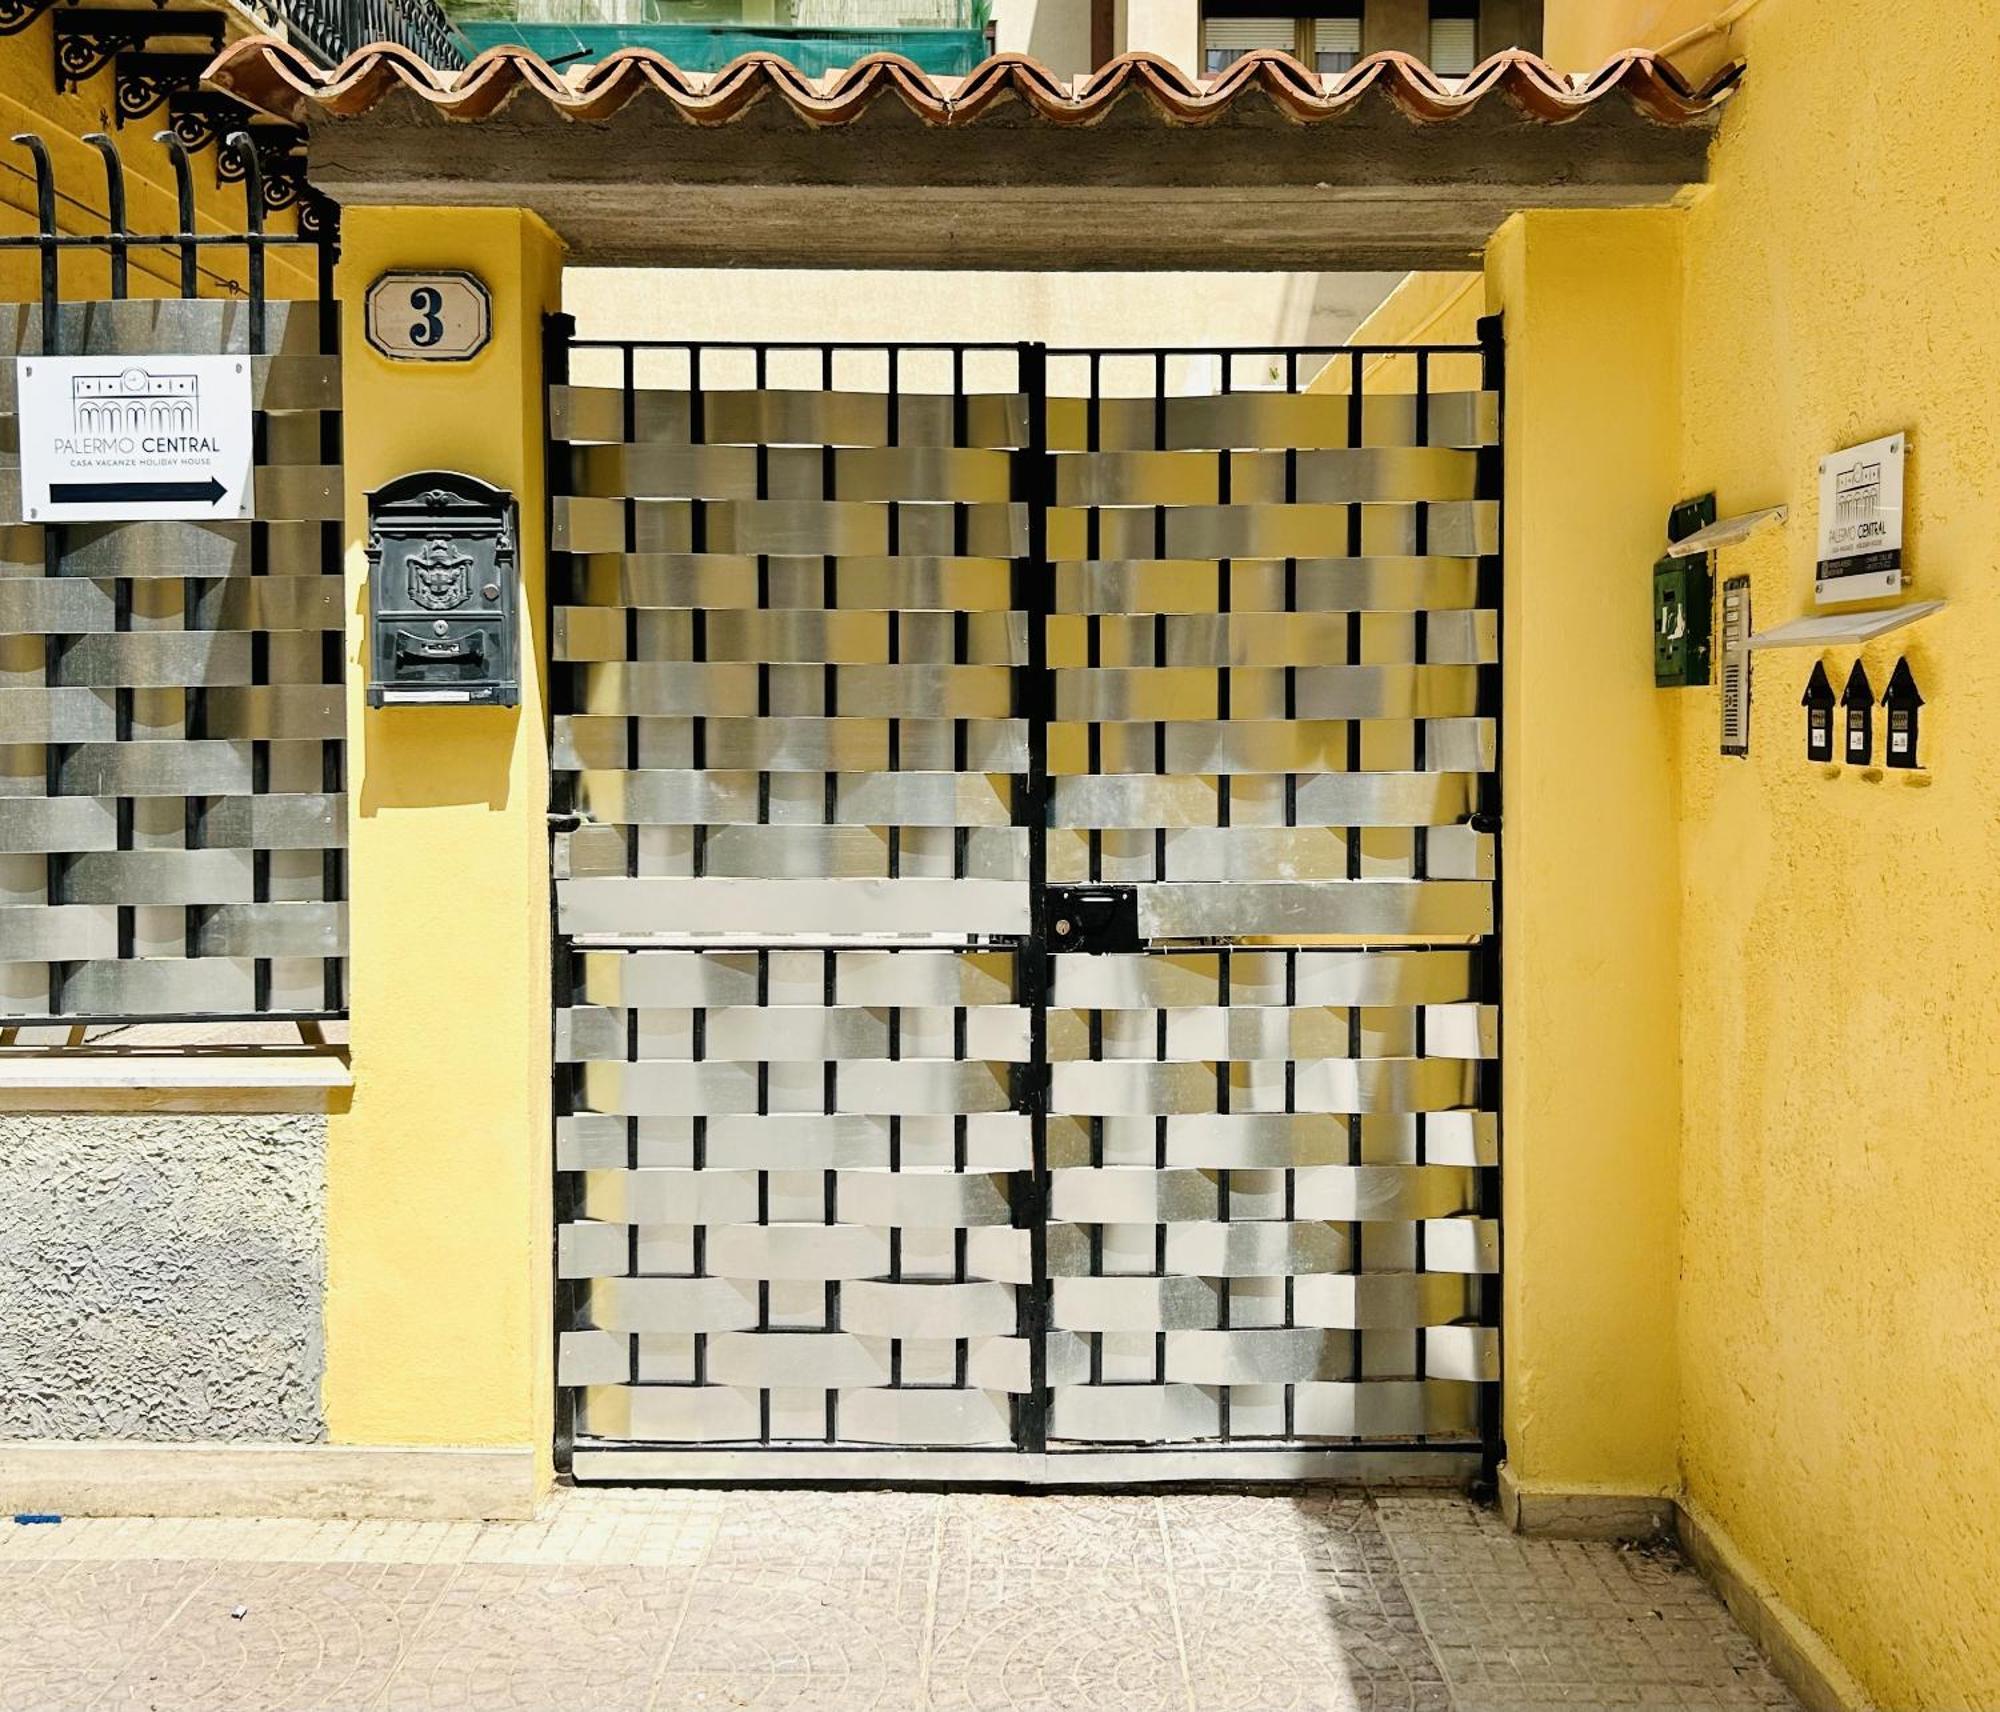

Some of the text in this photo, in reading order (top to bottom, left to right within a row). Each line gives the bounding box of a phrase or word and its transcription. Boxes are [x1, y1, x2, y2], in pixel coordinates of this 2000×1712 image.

[410, 287, 443, 346] 3
[54, 436, 220, 454] PALERMO CENTRAL
[70, 459, 93, 467] CASA
[139, 458, 178, 466] HOLIDAY
[180, 457, 211, 466] HOUSE
[1857, 520, 1887, 539] CENTRAL
